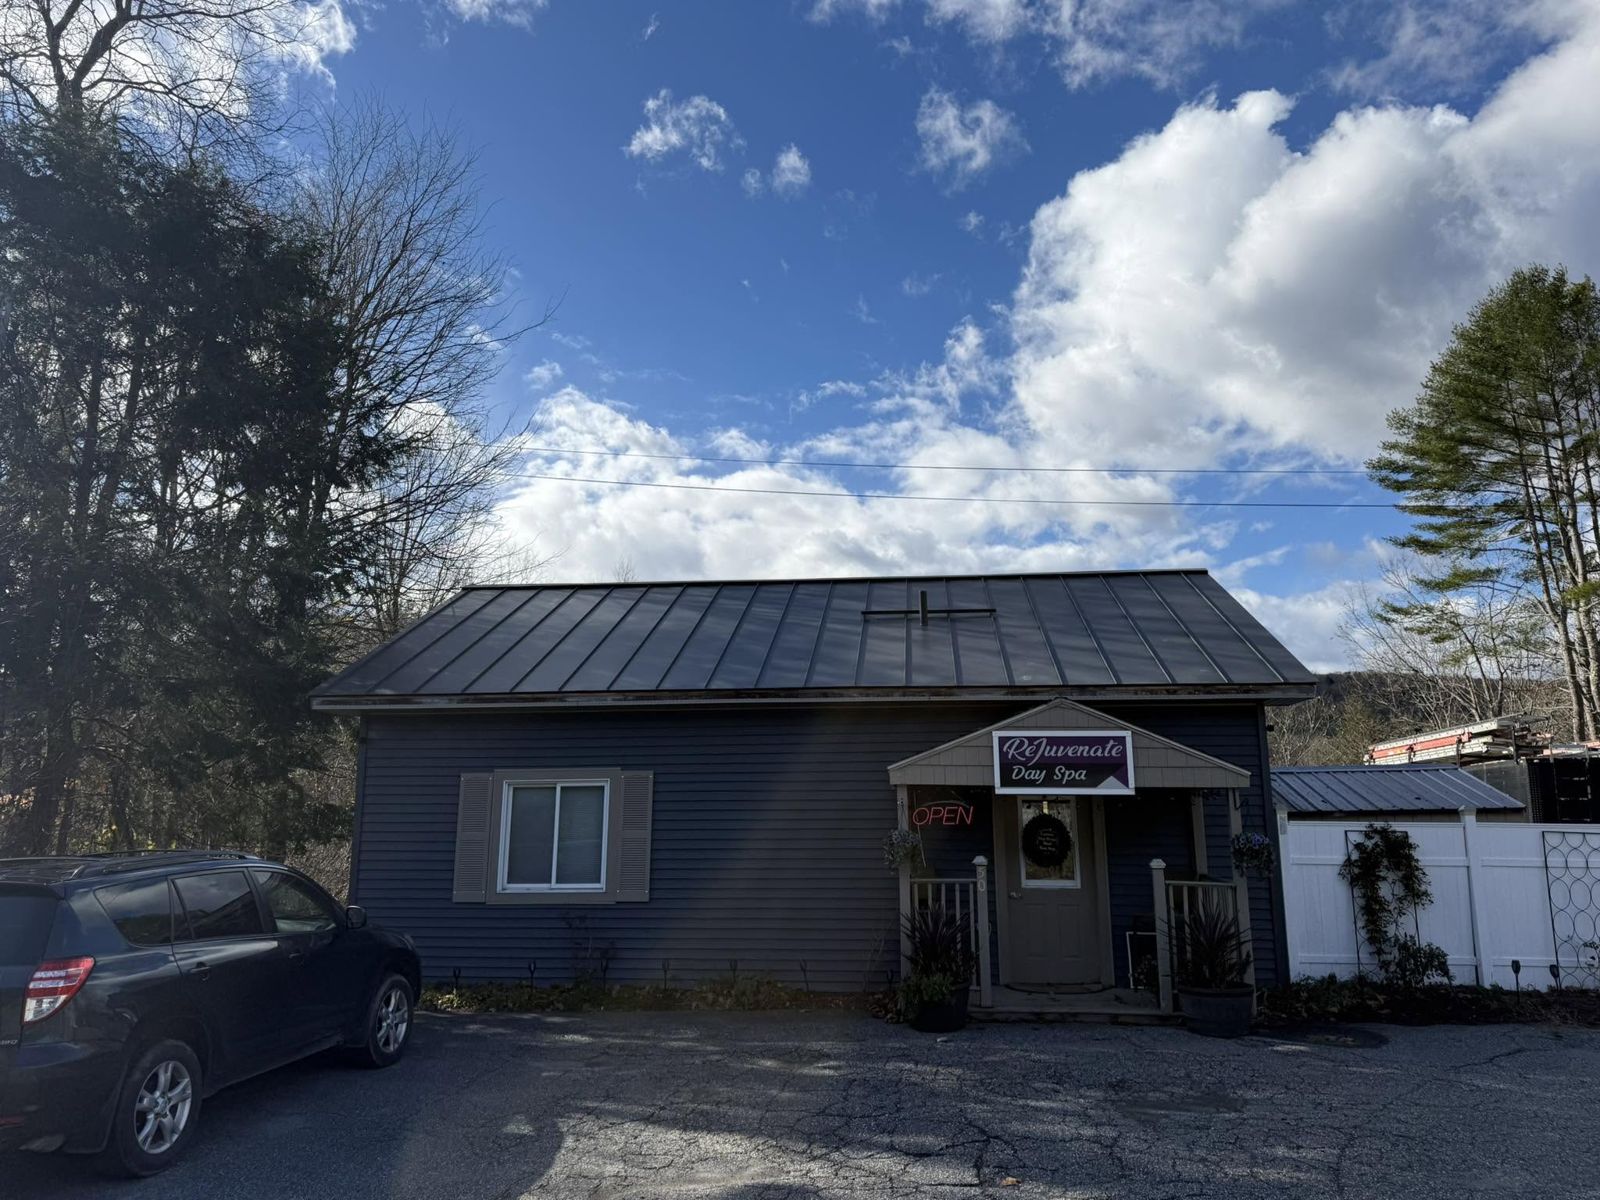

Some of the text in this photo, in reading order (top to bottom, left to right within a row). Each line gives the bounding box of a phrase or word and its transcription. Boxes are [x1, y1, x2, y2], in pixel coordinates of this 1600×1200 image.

[1012, 765, 1087, 784] Day Spa
[912, 806, 974, 825] OPEN
